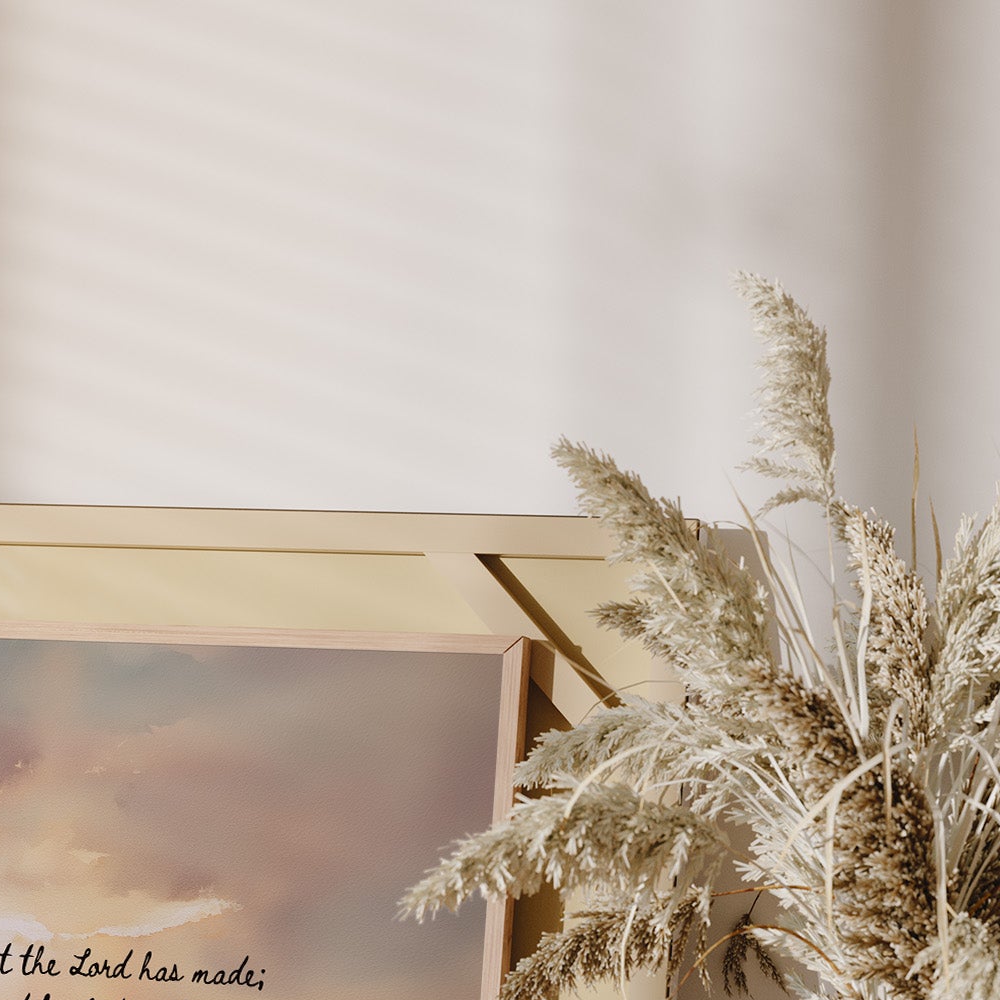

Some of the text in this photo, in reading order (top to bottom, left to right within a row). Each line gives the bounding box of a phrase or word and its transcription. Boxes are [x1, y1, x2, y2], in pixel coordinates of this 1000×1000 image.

[19, 941, 60, 978] the
[69, 948, 133, 980] Lord
[138, 951, 184, 982] has
[191, 955, 267, 992] made;
